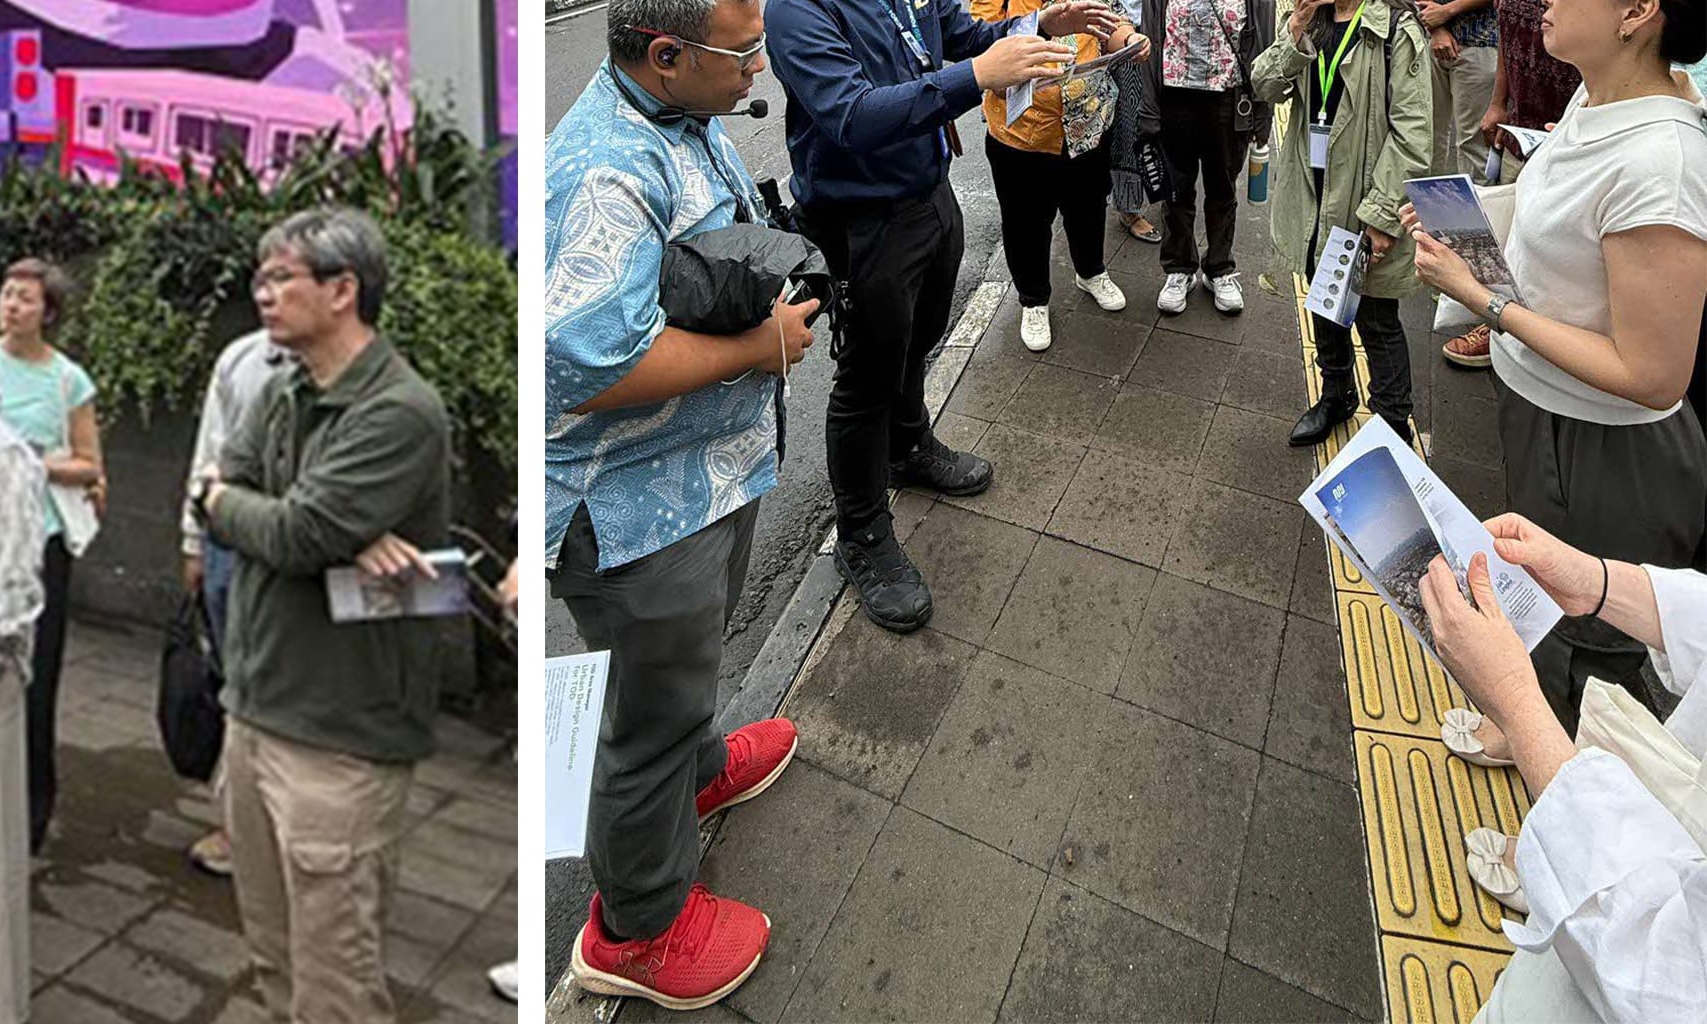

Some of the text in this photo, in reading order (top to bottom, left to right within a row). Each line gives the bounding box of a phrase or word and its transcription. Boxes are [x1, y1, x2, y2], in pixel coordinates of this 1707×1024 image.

[1143, 144, 1160, 191] MANILA
[568, 680, 578, 701] TOD
[578, 664, 588, 691] Urban
[572, 693, 583, 725] Design
